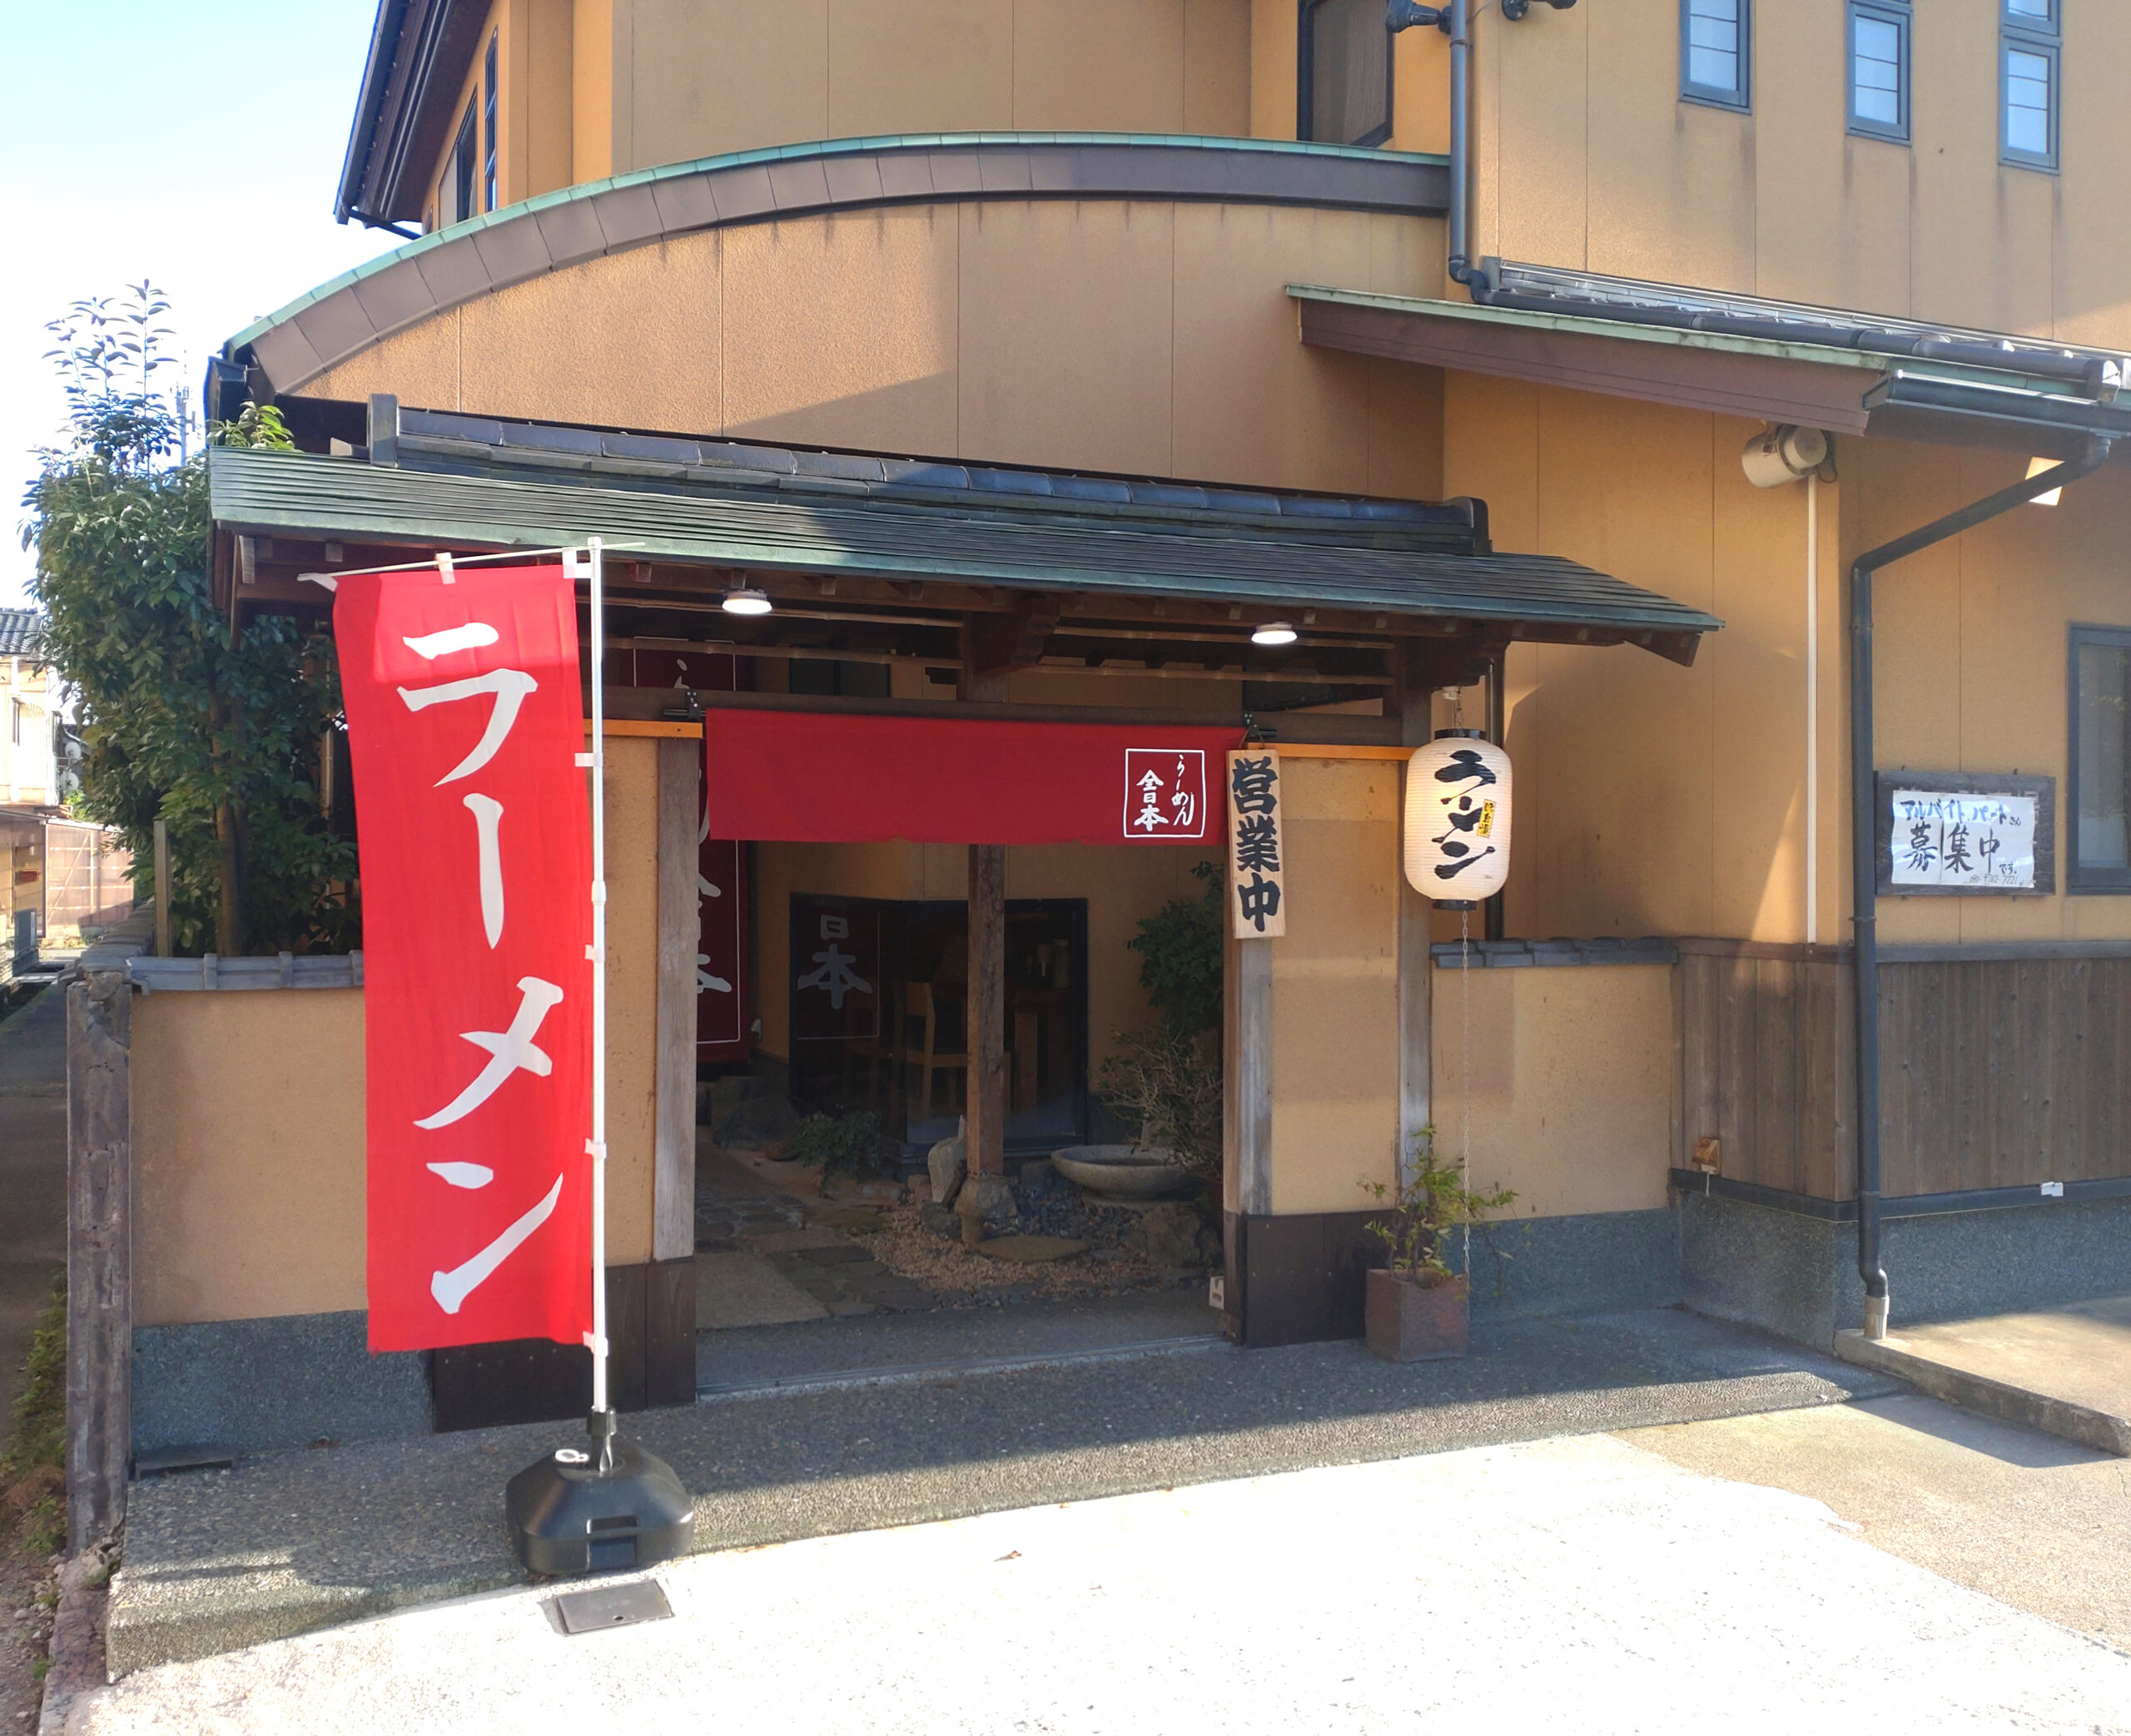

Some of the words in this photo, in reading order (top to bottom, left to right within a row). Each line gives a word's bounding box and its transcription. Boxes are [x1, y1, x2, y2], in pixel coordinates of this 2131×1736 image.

[1171, 754, 1195, 826] らーめん
[1232, 756, 1281, 932] 営業中
[1431, 750, 1497, 880] ラーメン
[396, 622, 564, 1316] ラーメン
